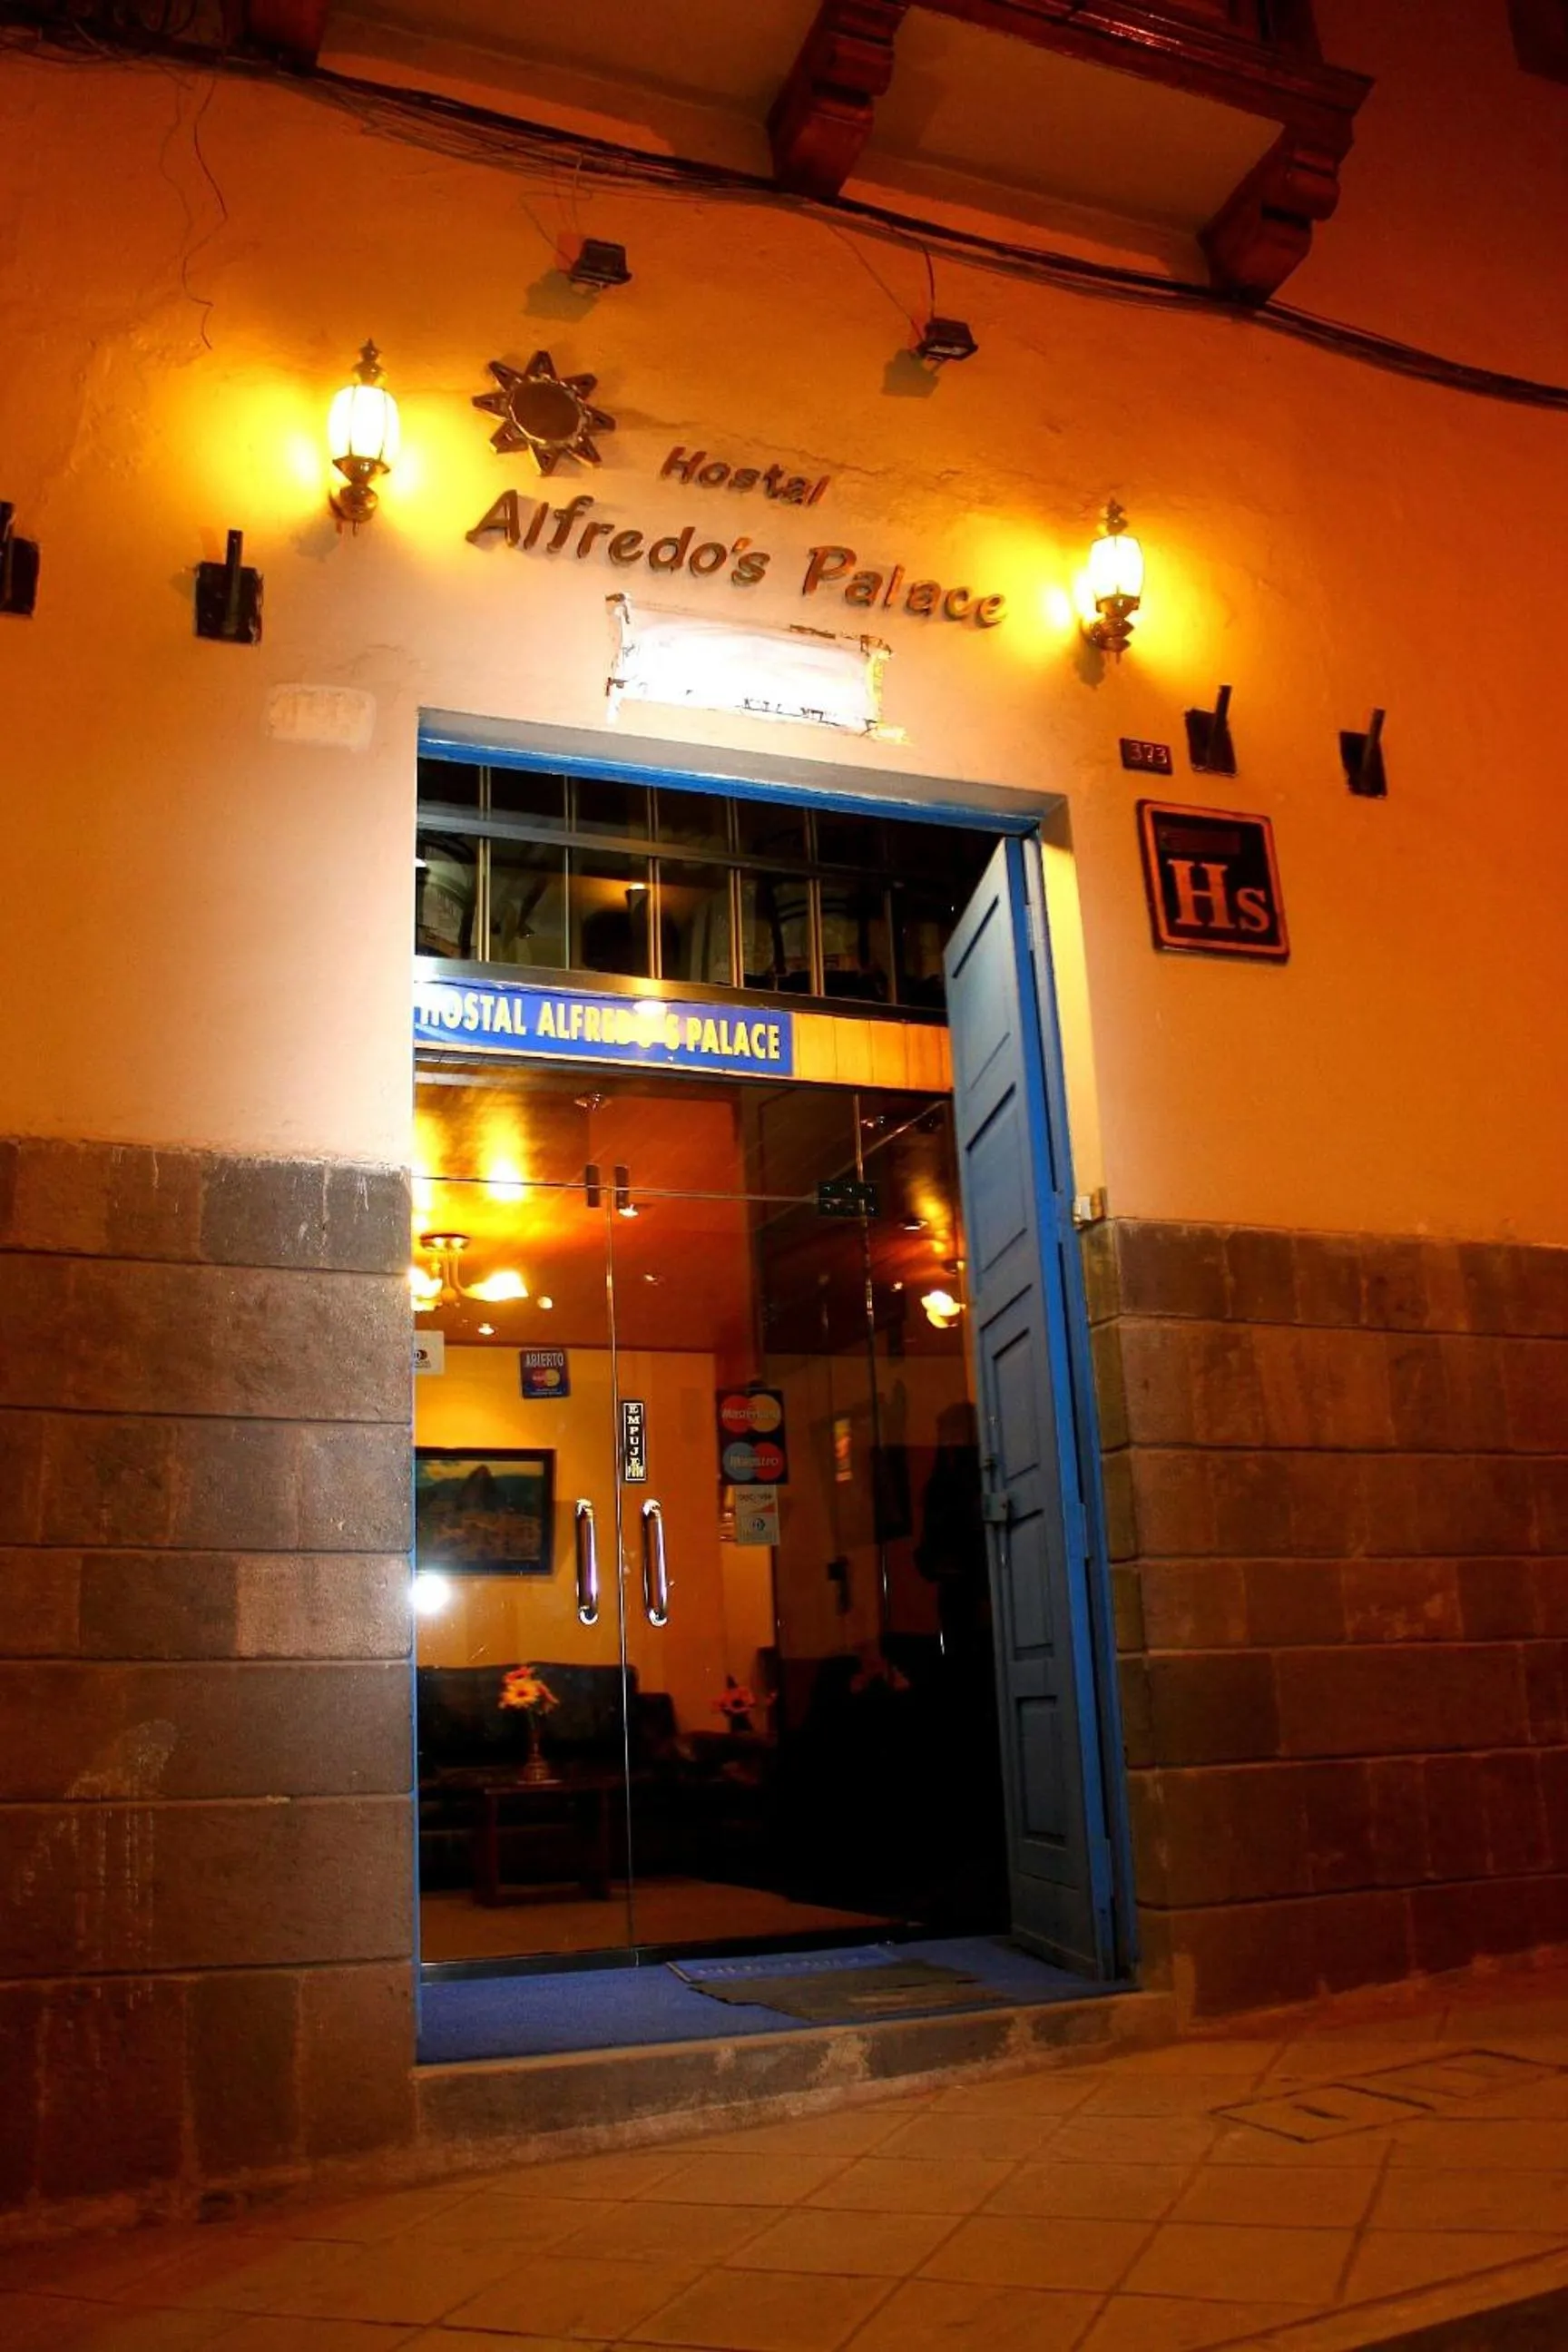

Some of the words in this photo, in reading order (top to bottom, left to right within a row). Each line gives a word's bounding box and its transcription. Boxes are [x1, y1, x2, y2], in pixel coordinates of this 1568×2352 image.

[660, 446, 831, 507] Hostal
[466, 488, 772, 589] Alfredo's
[801, 544, 1009, 630] Palace
[1130, 742, 1168, 764] 373
[536, 1001, 680, 1050] ALFREDS
[686, 1016, 781, 1060] PALACE
[525, 1352, 564, 1367] ABIERTO
[627, 1405, 641, 1466] EMPUJE
